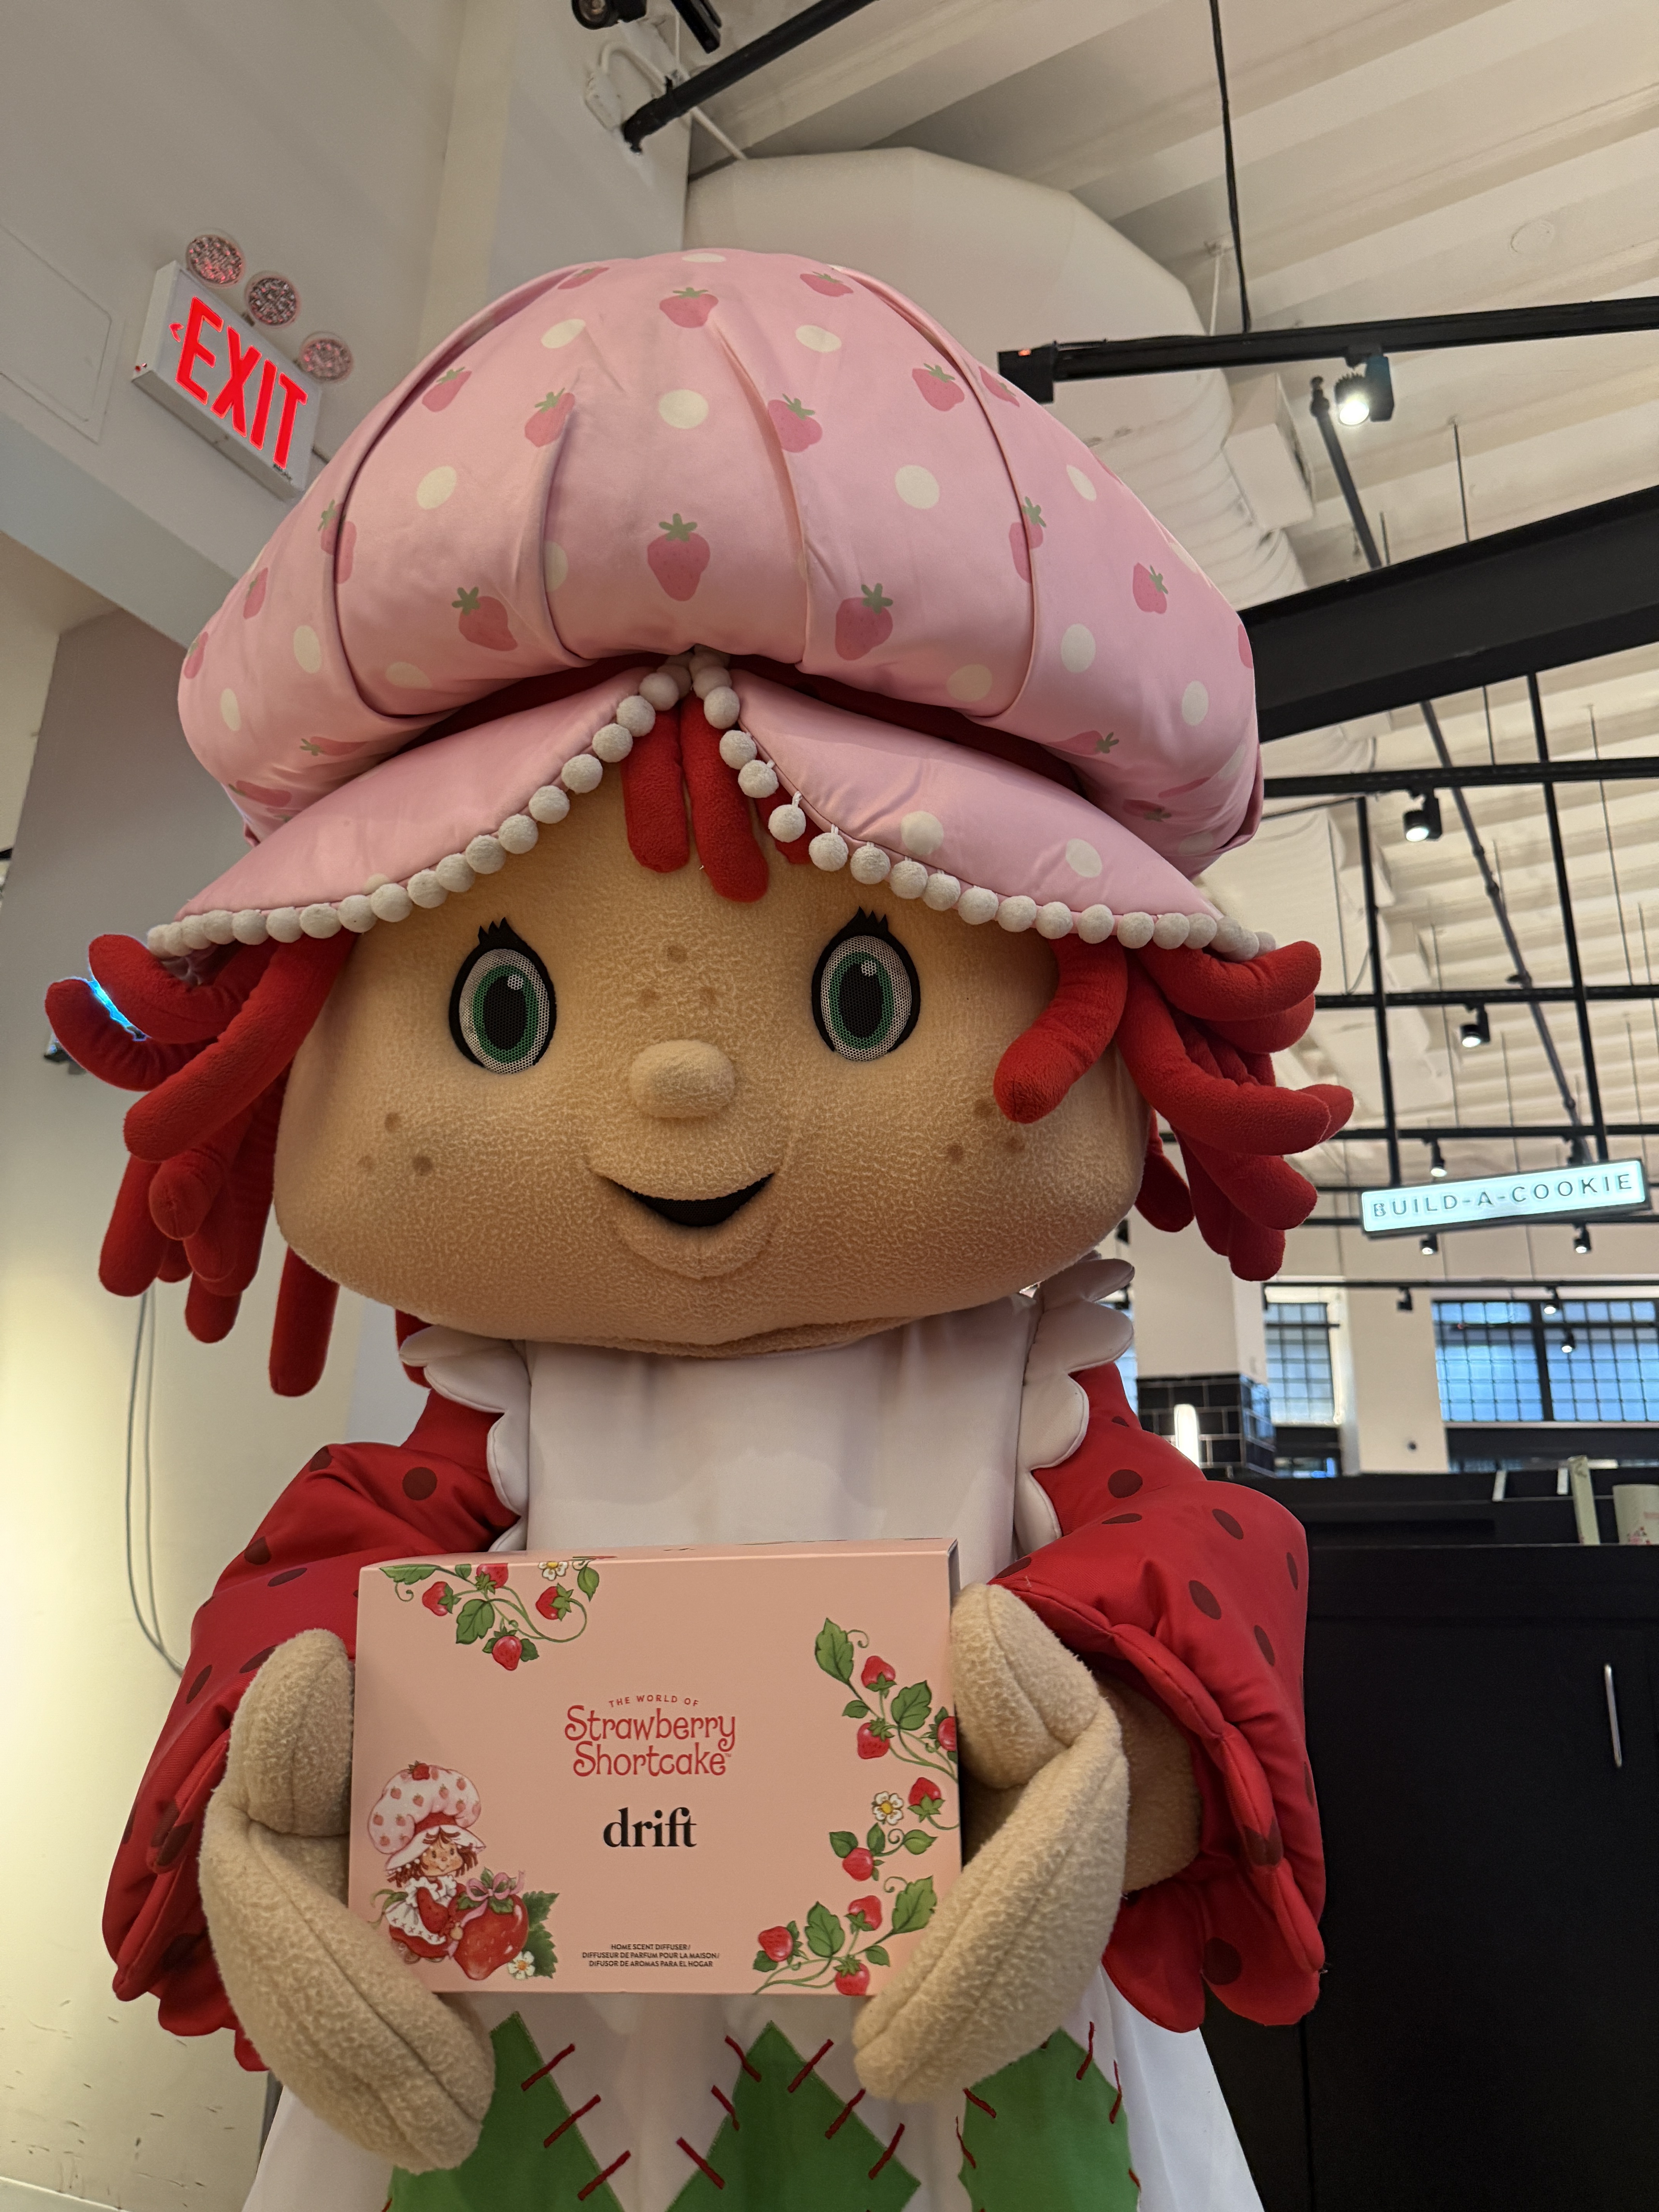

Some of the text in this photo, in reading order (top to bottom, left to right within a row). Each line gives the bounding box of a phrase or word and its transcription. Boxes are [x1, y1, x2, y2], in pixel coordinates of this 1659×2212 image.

[175, 296, 309, 469] EXIT
[1374, 1173, 1633, 1217] BUILD-A-COOKIE
[608, 1694, 699, 1708] THE WORLD OF
[565, 1705, 735, 1752] Strawberry
[603, 1807, 697, 1847] drift
